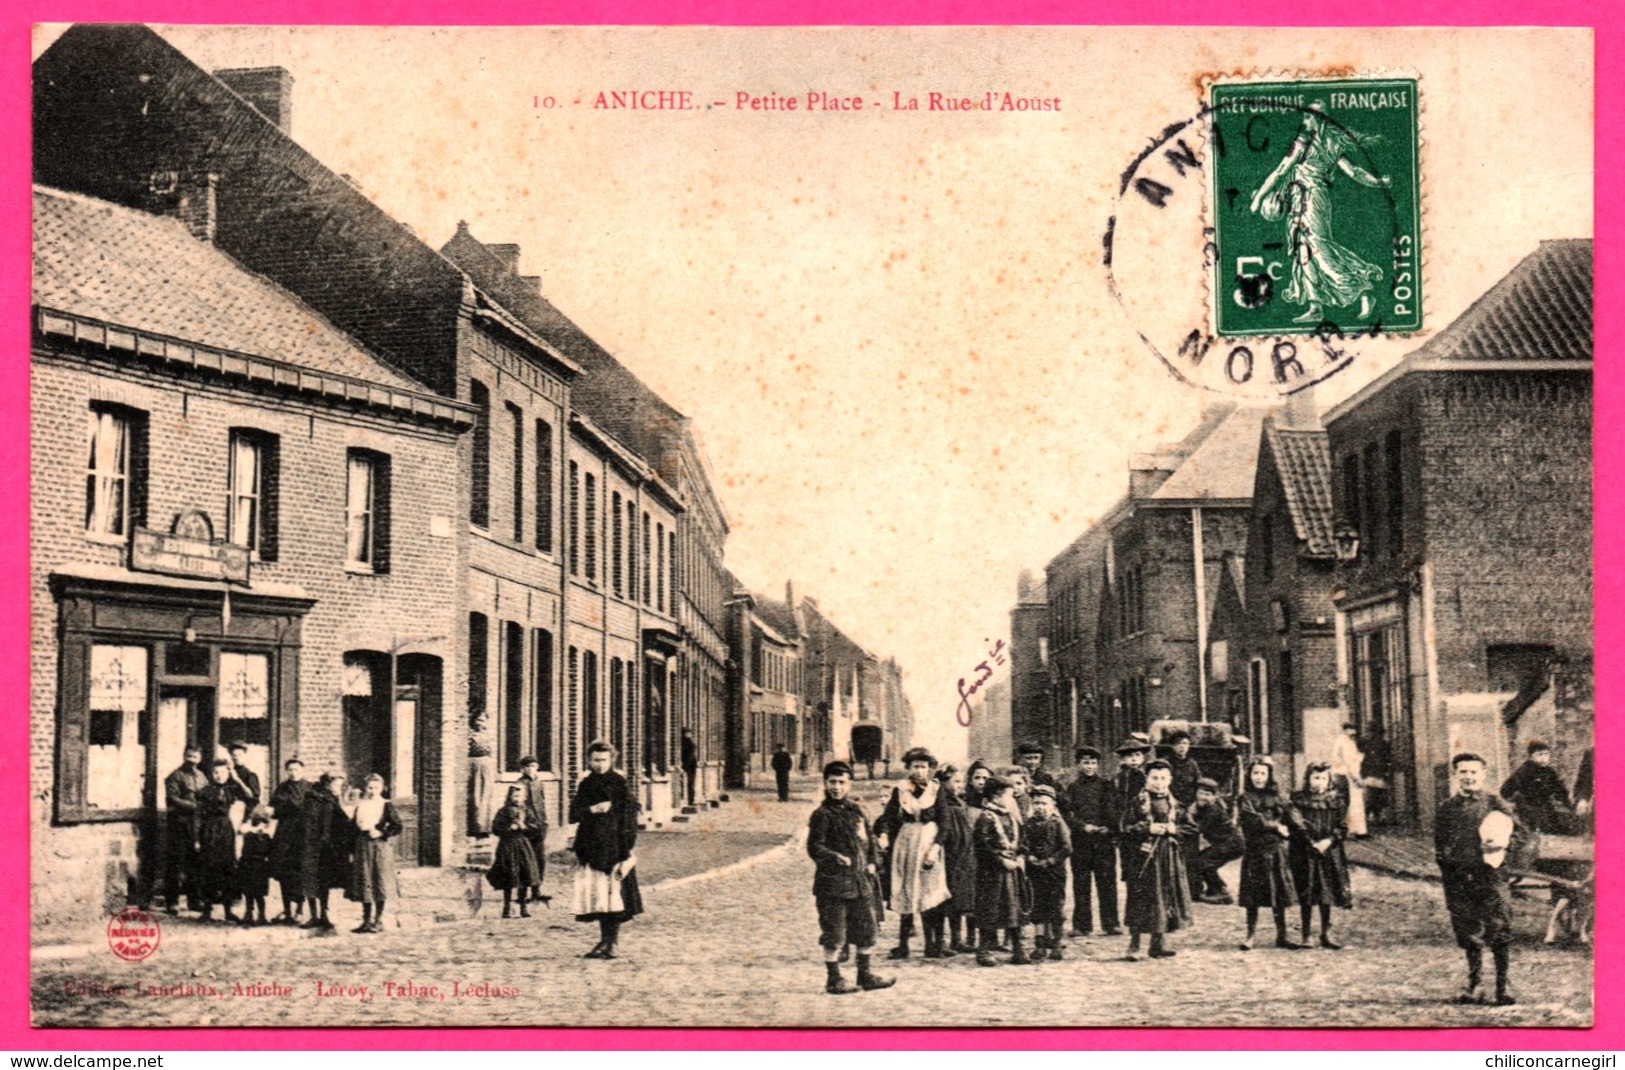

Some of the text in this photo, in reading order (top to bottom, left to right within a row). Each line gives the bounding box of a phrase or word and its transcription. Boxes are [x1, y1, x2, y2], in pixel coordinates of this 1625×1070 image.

[735, 91, 798, 111] Petite
[806, 91, 864, 111] Place
[892, 91, 919, 111] La
[928, 91, 972, 111] Rue
[1330, 91, 1408, 112] FRANÇAISE
[1394, 233, 1413, 316] POSTES
[232, 981, 293, 998] Aniche
[316, 981, 374, 1003] Leroy,
[383, 981, 445, 1001] Tabac,
